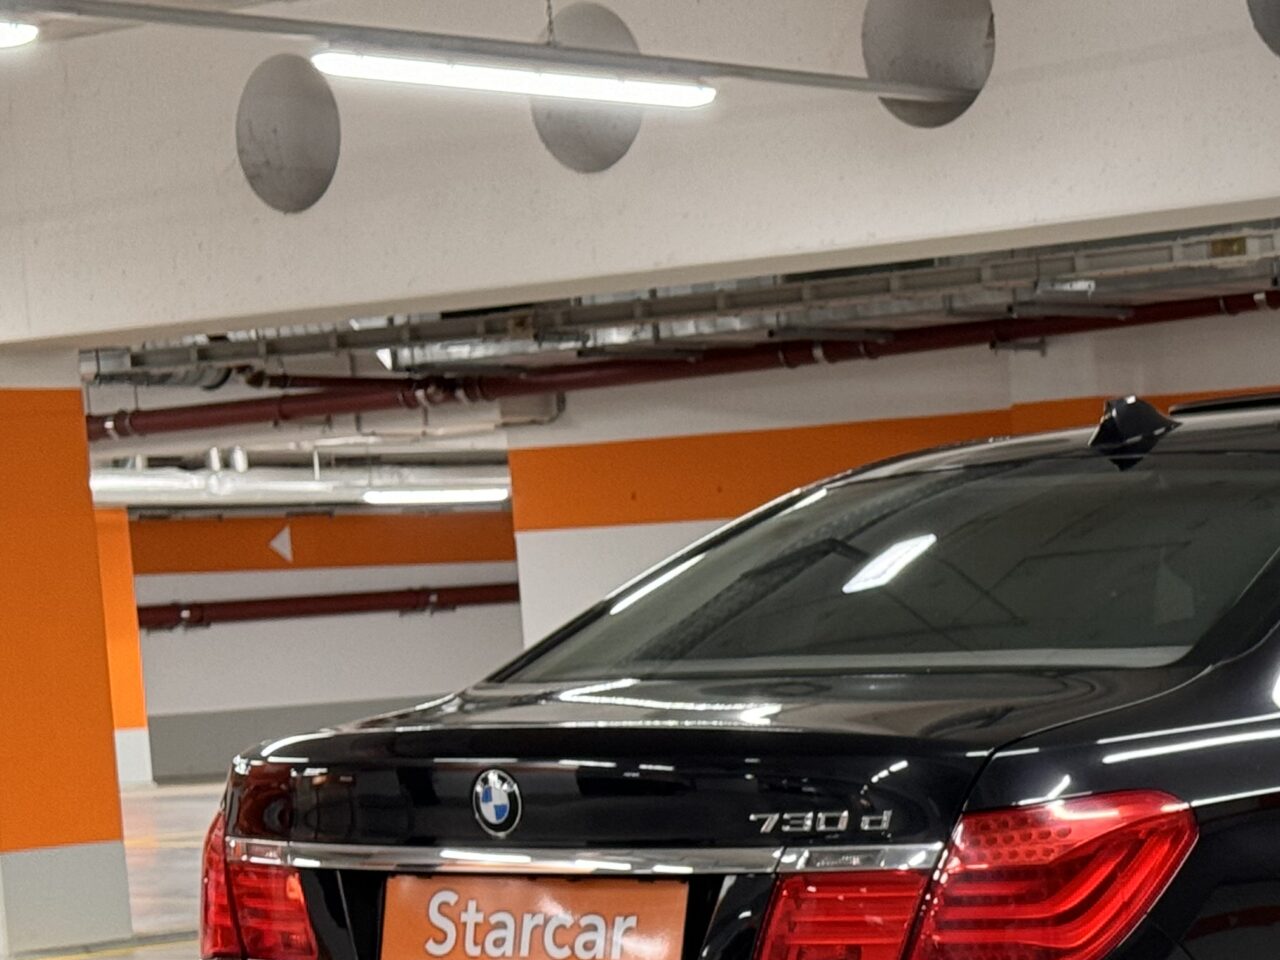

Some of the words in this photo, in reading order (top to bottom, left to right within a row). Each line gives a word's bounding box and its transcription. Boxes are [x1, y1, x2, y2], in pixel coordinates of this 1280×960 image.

[749, 810, 849, 833] 730
[860, 810, 893, 831] d
[425, 890, 638, 960] Starcar
